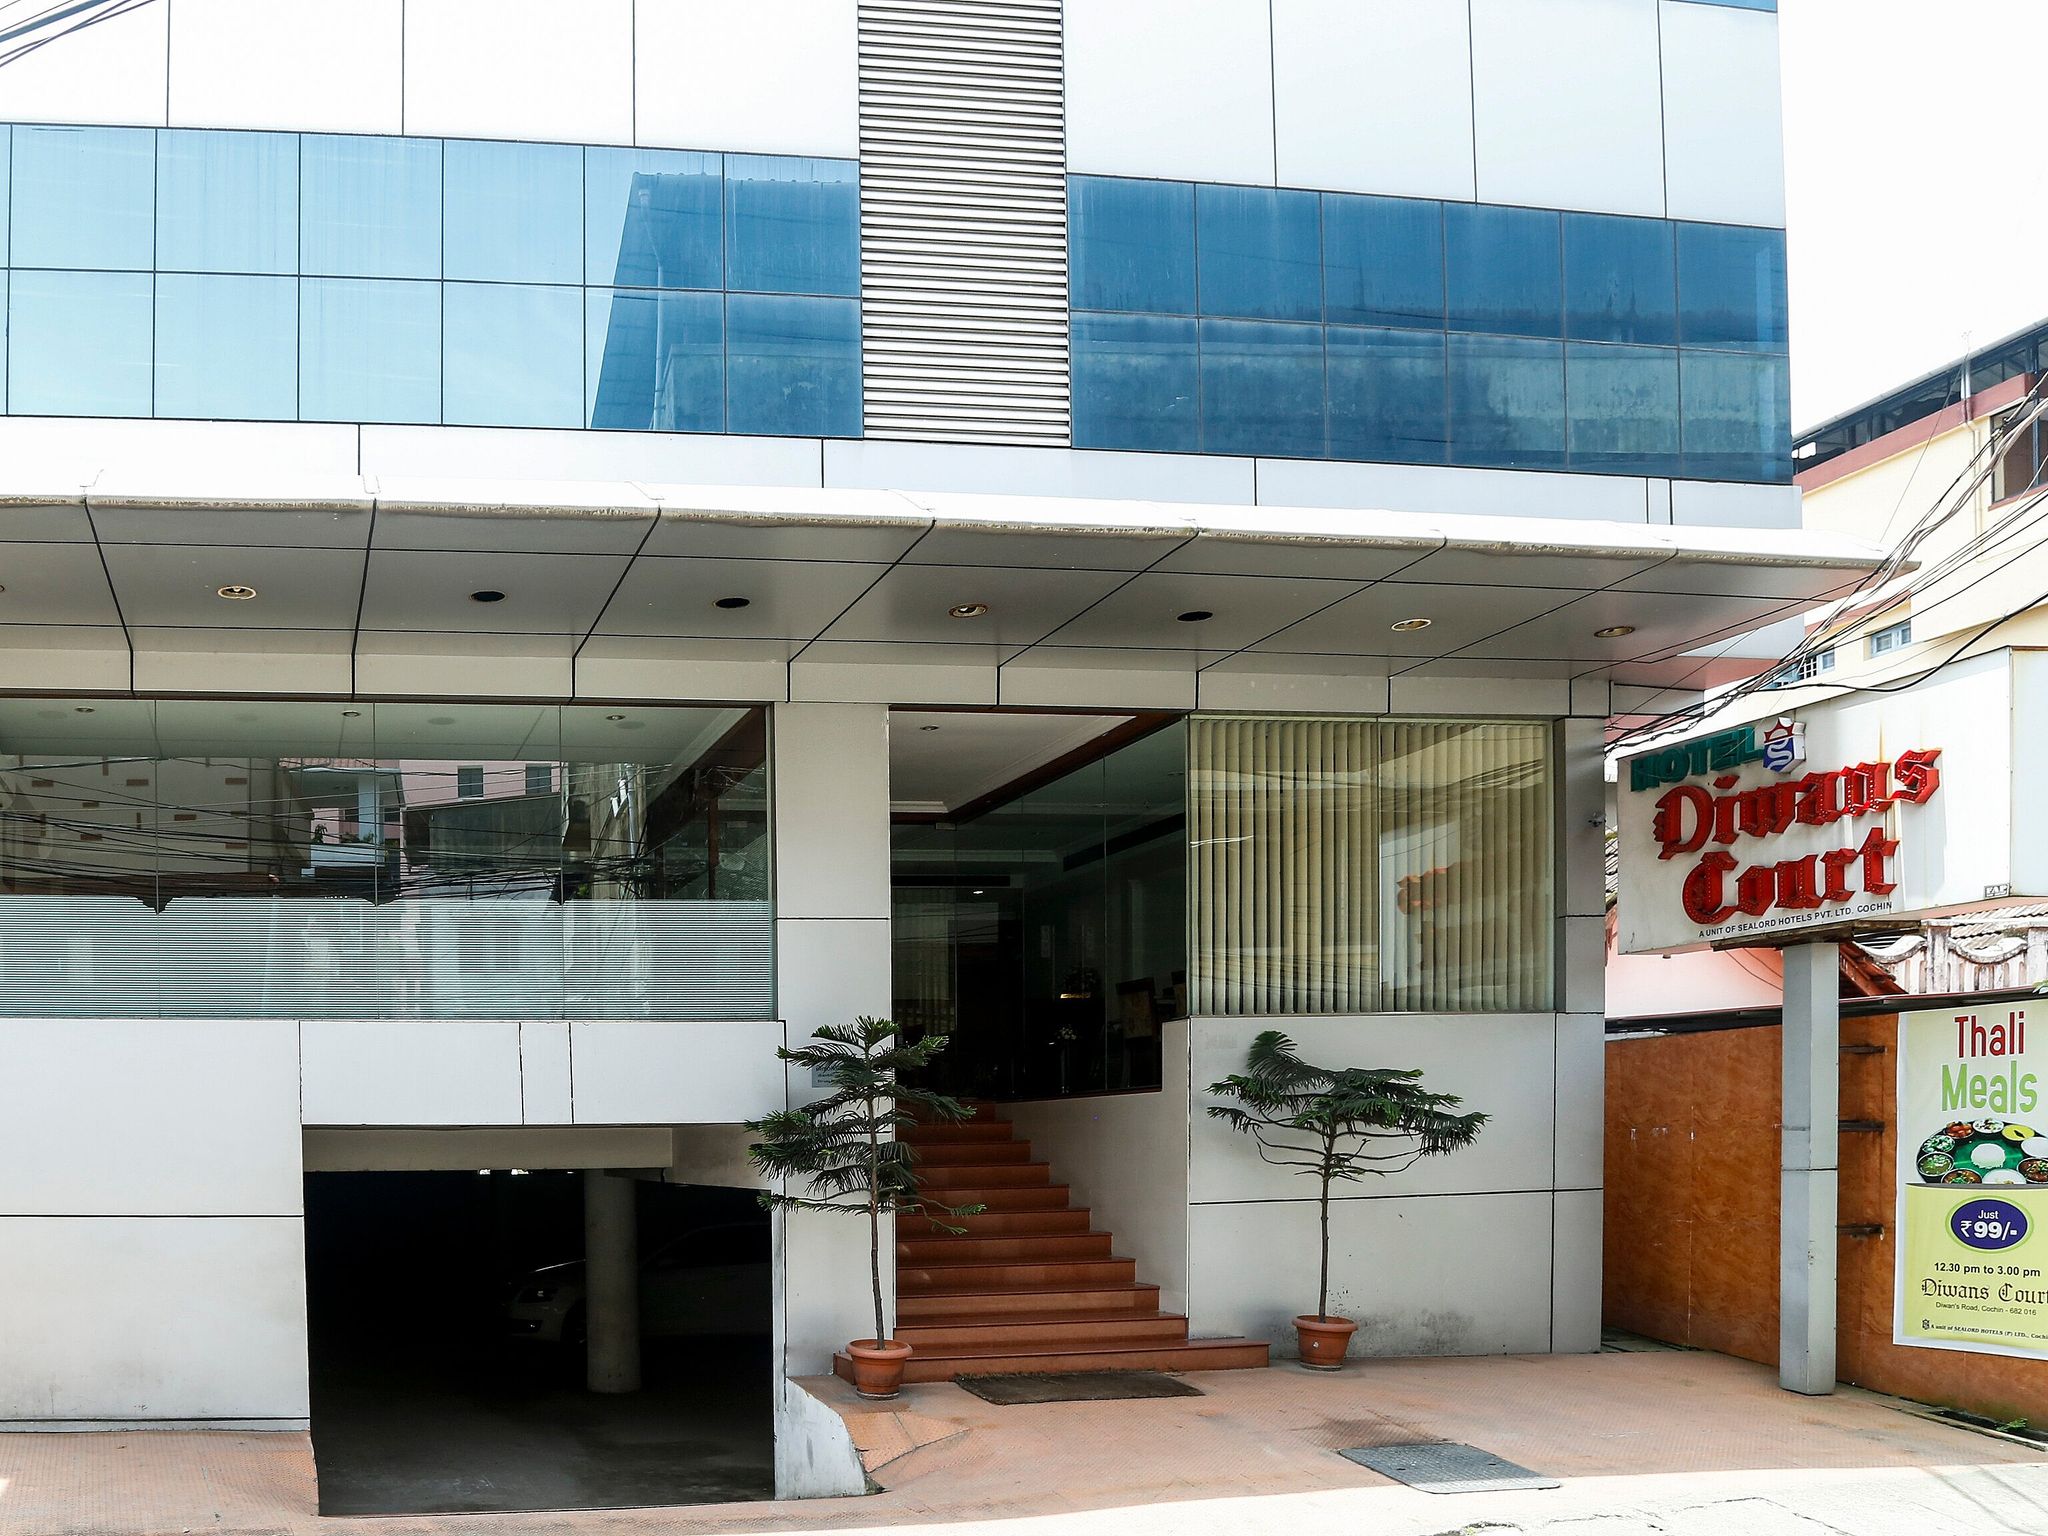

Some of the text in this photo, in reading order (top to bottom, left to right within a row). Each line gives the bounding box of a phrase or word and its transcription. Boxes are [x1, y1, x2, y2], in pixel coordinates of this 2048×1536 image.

[1631, 727, 1764, 792] HOTEL
[1653, 748, 1943, 860] Diwans
[1682, 827, 1900, 925] Court
[1698, 901, 1893, 938] A UNIT OF SEALORD HOTELS PVT. LTD. COCHIN
[1954, 1011, 2025, 1058] Thali
[1941, 1060, 2038, 1114] Meals
[1978, 1209, 1999, 1220] Just
[1921, 1278, 1989, 1300] Diwans
[1934, 1262, 2041, 1279] 12.30 pm to 3.00 pm
[1935, 1301, 1960, 1310] Diwan's
[1981, 1305, 2004, 1313] Cochin
[2009, 1307, 2023, 1315] 682
